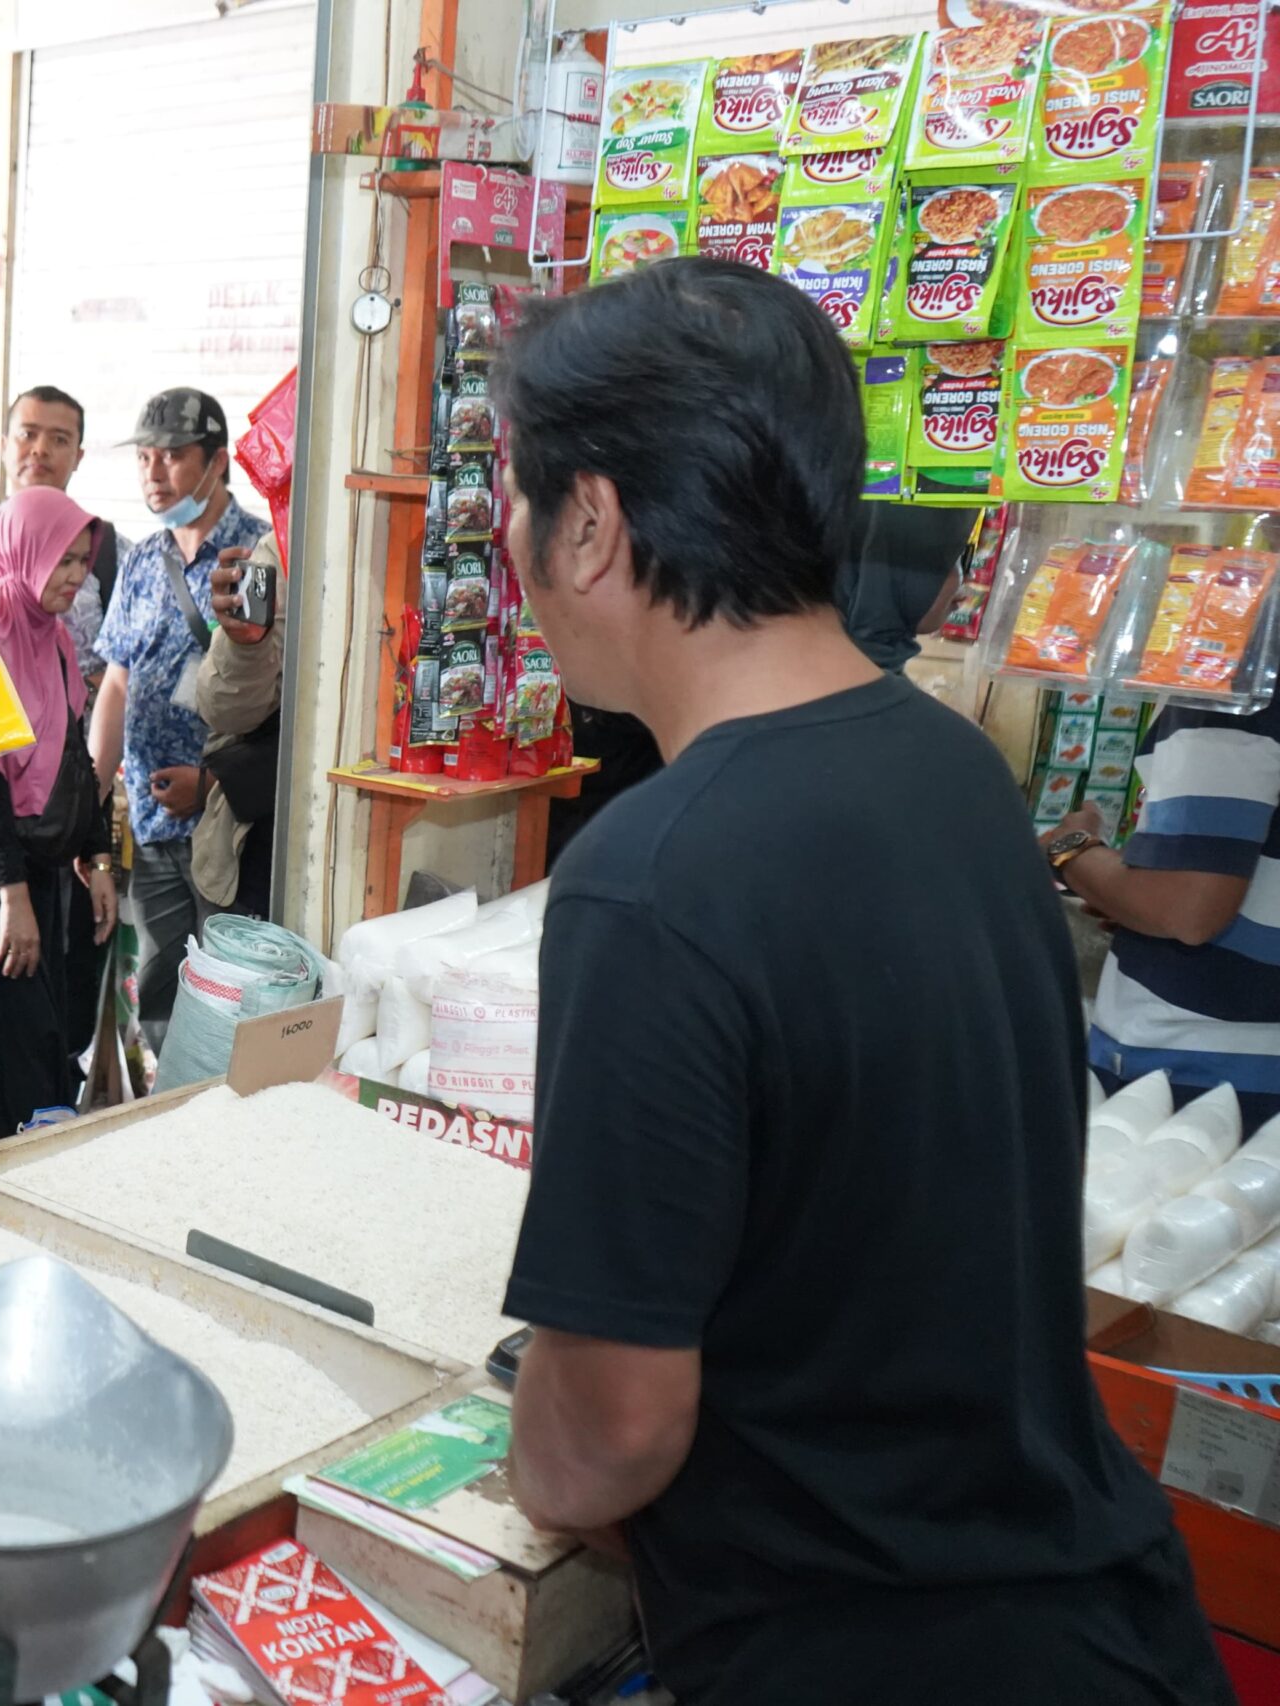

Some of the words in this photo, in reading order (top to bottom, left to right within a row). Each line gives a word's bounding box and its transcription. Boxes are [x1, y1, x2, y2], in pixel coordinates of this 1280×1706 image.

[932, 92, 983, 110] Gorng
[984, 86, 1023, 103] Nasi
[1045, 94, 1101, 111] GRENG
[1104, 89, 1141, 103] NASI
[1193, 90, 1249, 106] SAORI
[714, 87, 789, 123] Sajiku
[934, 108, 999, 140] Siku
[1045, 107, 1138, 149] Sajiku
[616, 137, 635, 151] Sop
[637, 131, 673, 149] Sayur
[609, 153, 662, 181] Sajiku
[911, 260, 954, 272] GORENG
[956, 259, 987, 272] NASI
[1031, 261, 1085, 275] GORENG
[1088, 259, 1122, 272] NASI
[797, 278, 831, 291] GORE
[833, 277, 863, 291] IKAN
[463, 287, 489, 302] SAORI
[907, 273, 981, 312] Sajiku
[1031, 275, 1123, 315] Sajiku
[923, 391, 974, 404] GORENG
[923, 405, 998, 442] Sajiku
[1018, 424, 1069, 437] GORENG
[1074, 424, 1108, 436] NASI
[1018, 438, 1106, 478] Sajiku
[457, 561, 482, 576] SAORI
[451, 648, 478, 664] SAORI
[524, 657, 552, 671] SAORI
[281, 1019, 313, 1040] 16000
[451, 1076, 494, 1089] RINGGIT
[276, 1612, 334, 1637] NOTA
[260, 1619, 375, 1664] KONTAN
